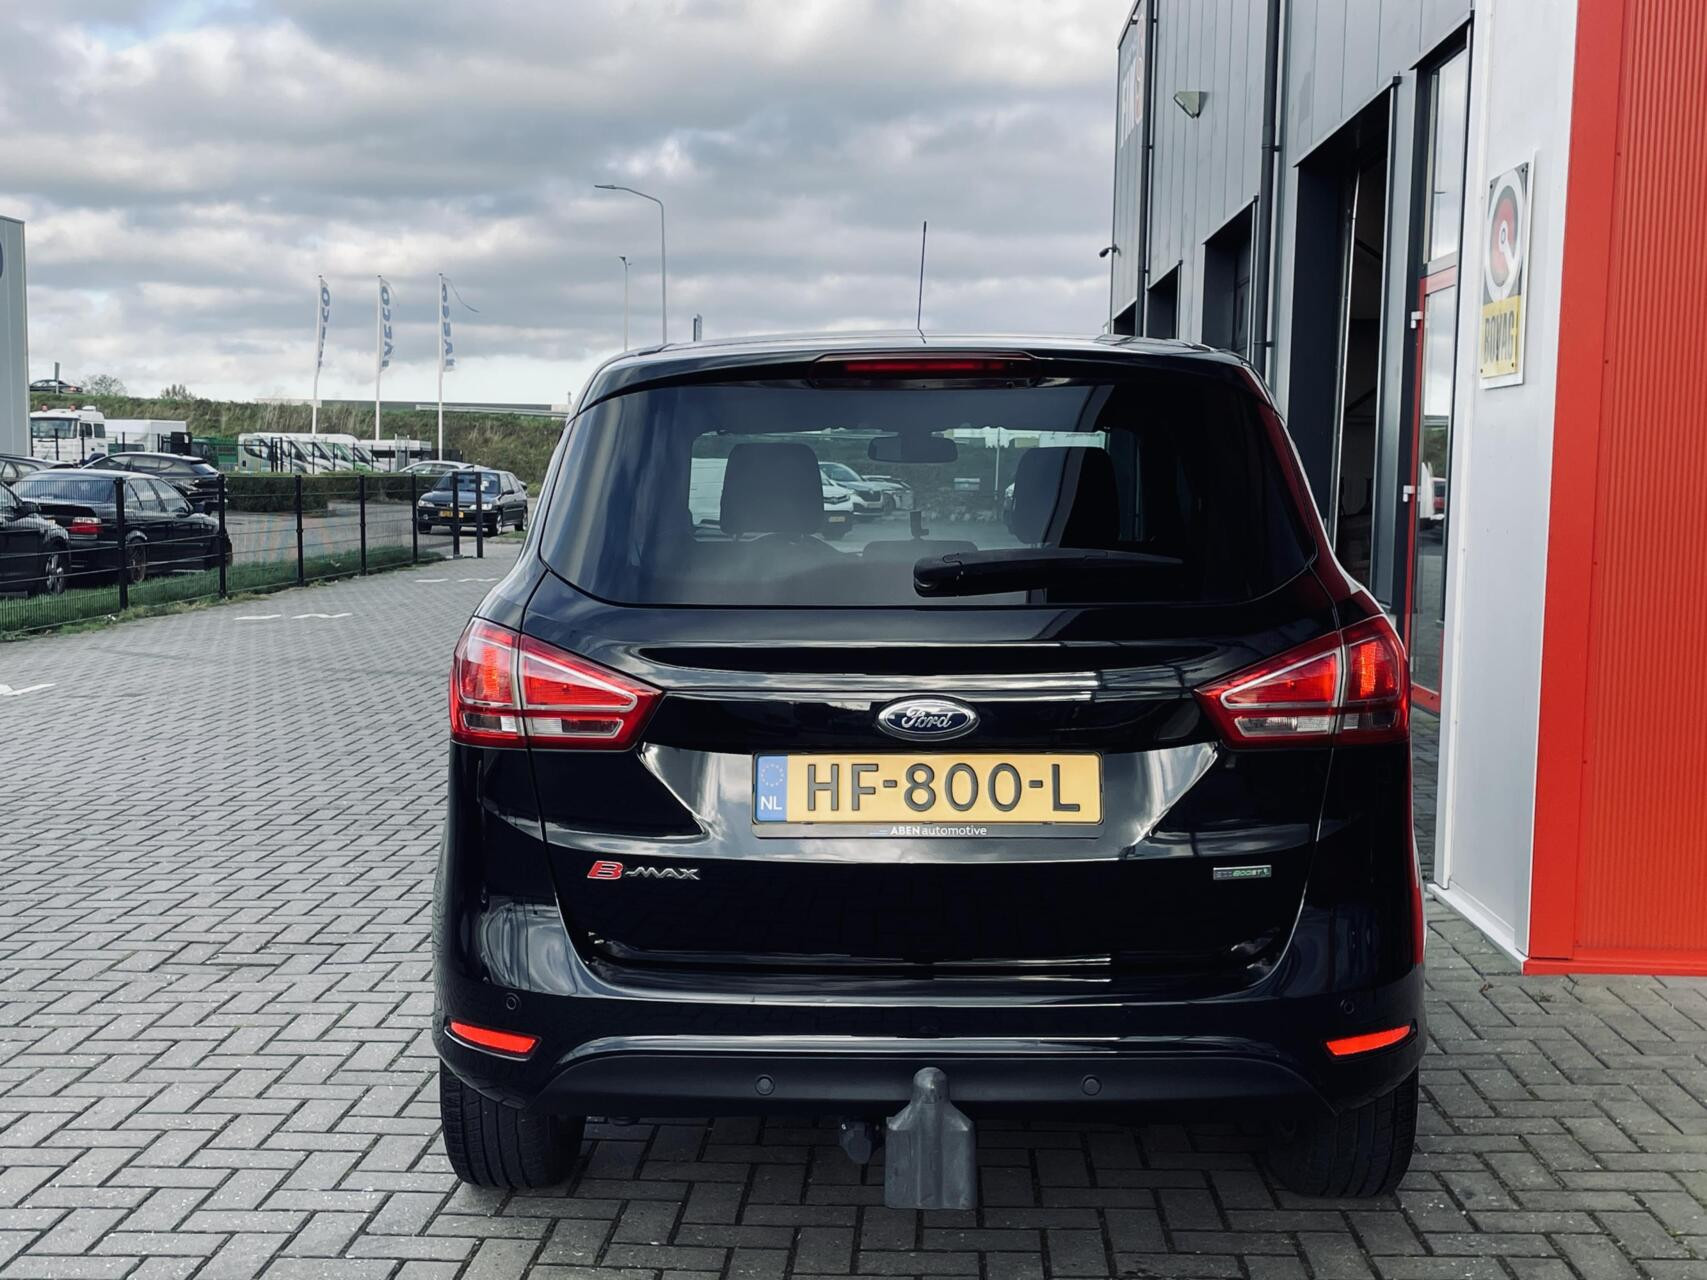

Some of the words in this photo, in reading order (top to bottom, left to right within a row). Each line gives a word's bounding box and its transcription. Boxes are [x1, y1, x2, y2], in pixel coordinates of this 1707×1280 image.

[381, 286, 393, 367] IVECO
[1484, 310, 1515, 363] BOVAG
[901, 706, 952, 729] Ford
[760, 796, 783, 811] NL
[807, 762, 1081, 813] HF-800-L
[587, 860, 700, 880] B-MAX
